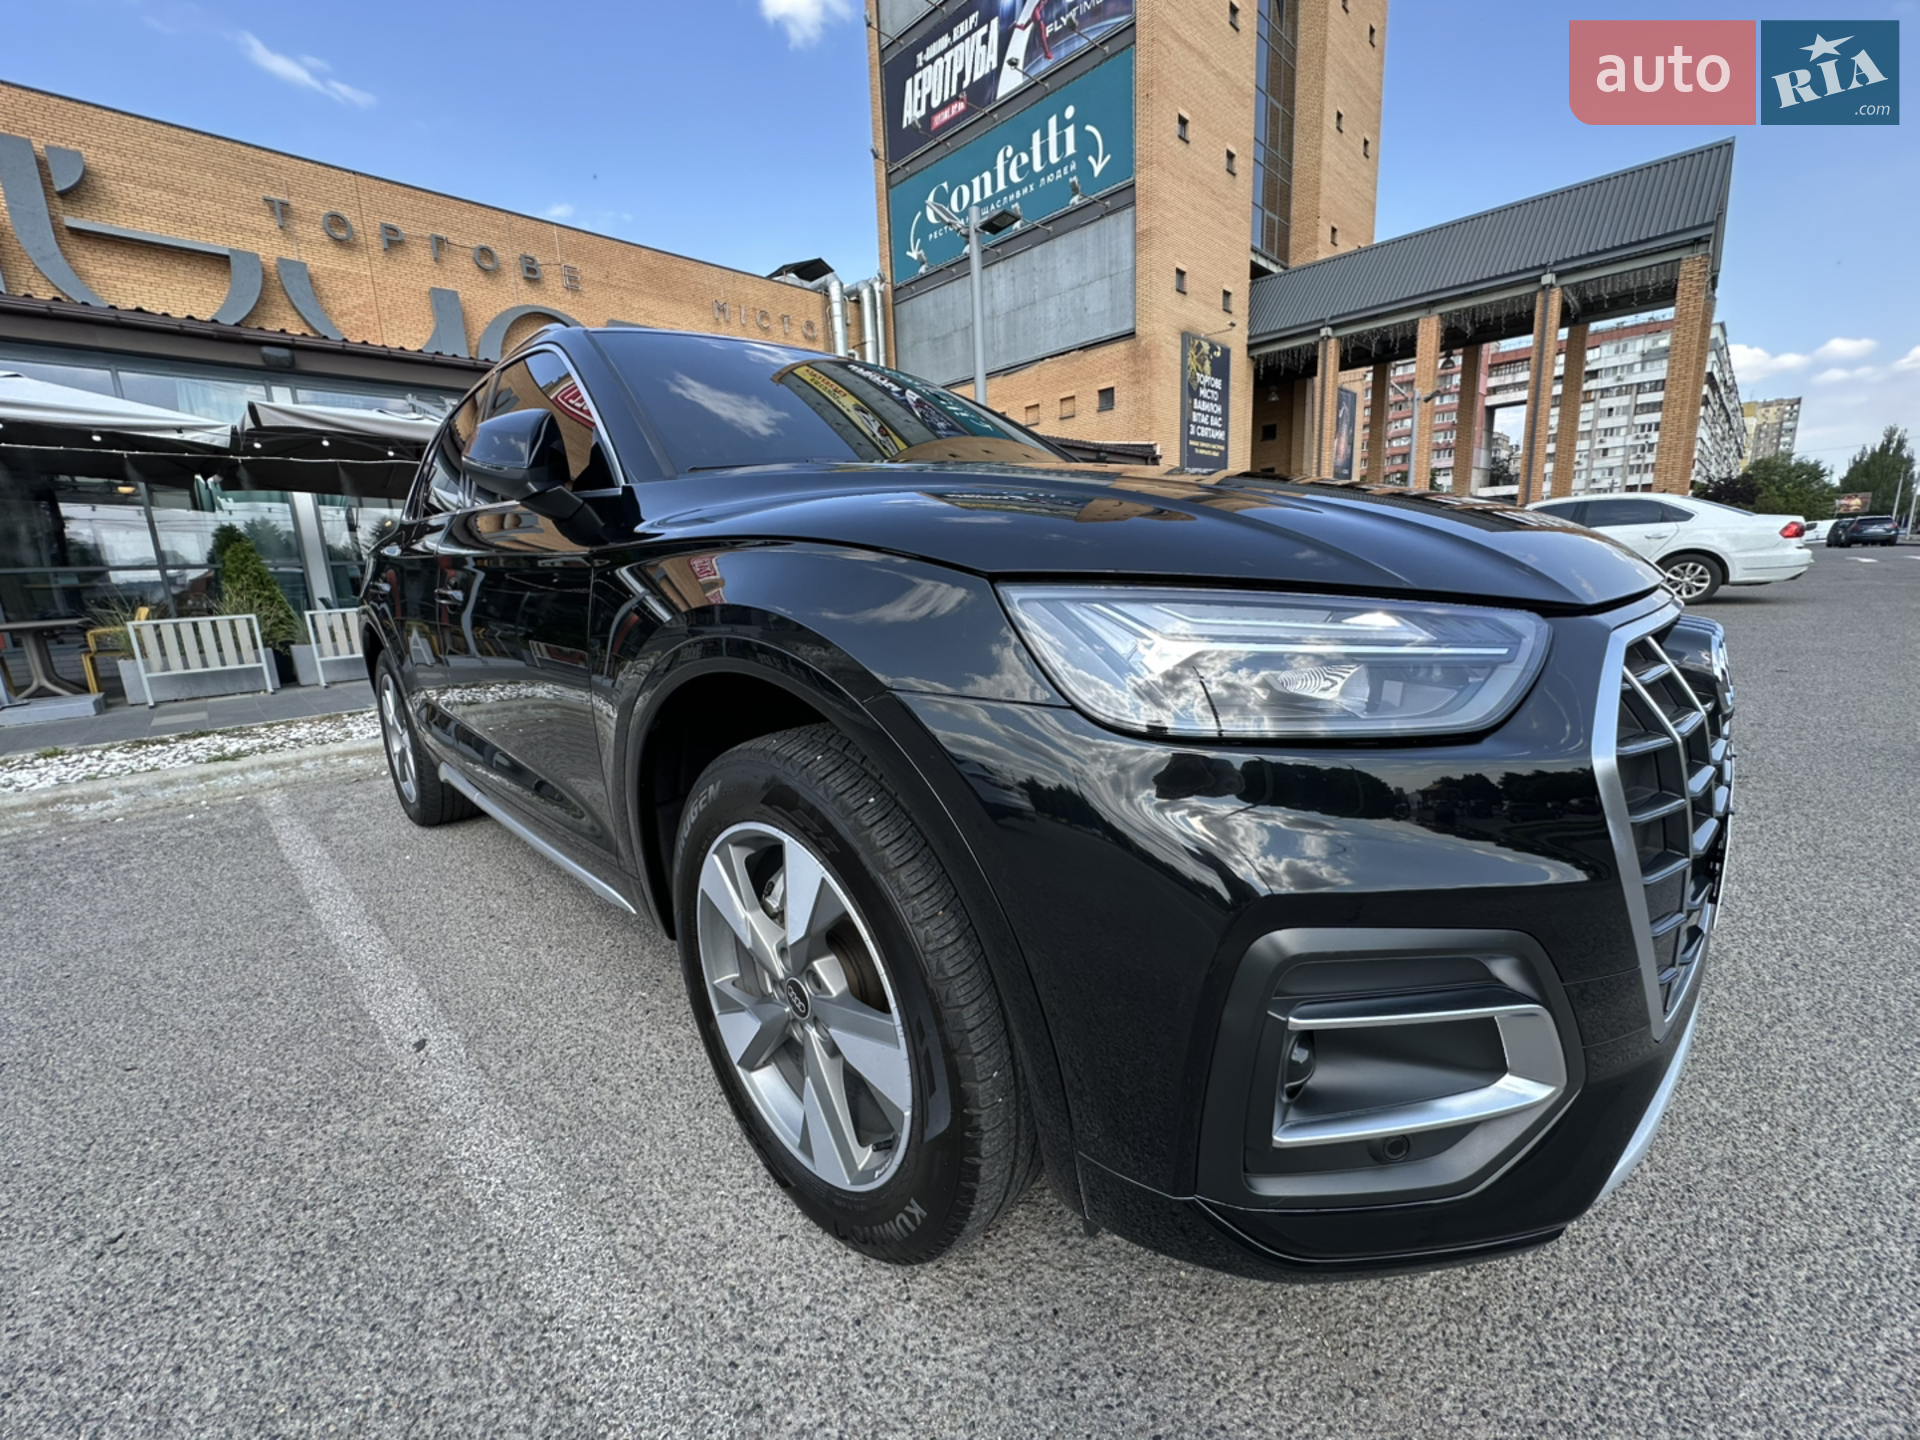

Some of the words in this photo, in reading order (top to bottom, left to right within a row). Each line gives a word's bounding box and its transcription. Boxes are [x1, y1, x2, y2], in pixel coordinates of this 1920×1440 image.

[902, 16, 999, 129] АЕРОТРУБА
[925, 105, 1077, 224] Confetti
[981, 182, 1035, 216] ЩАСЛИВИХ
[1039, 159, 1077, 188] ЛЮДЕЙ
[262, 195, 581, 290] ТОРГОВЕ
[714, 299, 818, 341] МІСТО
